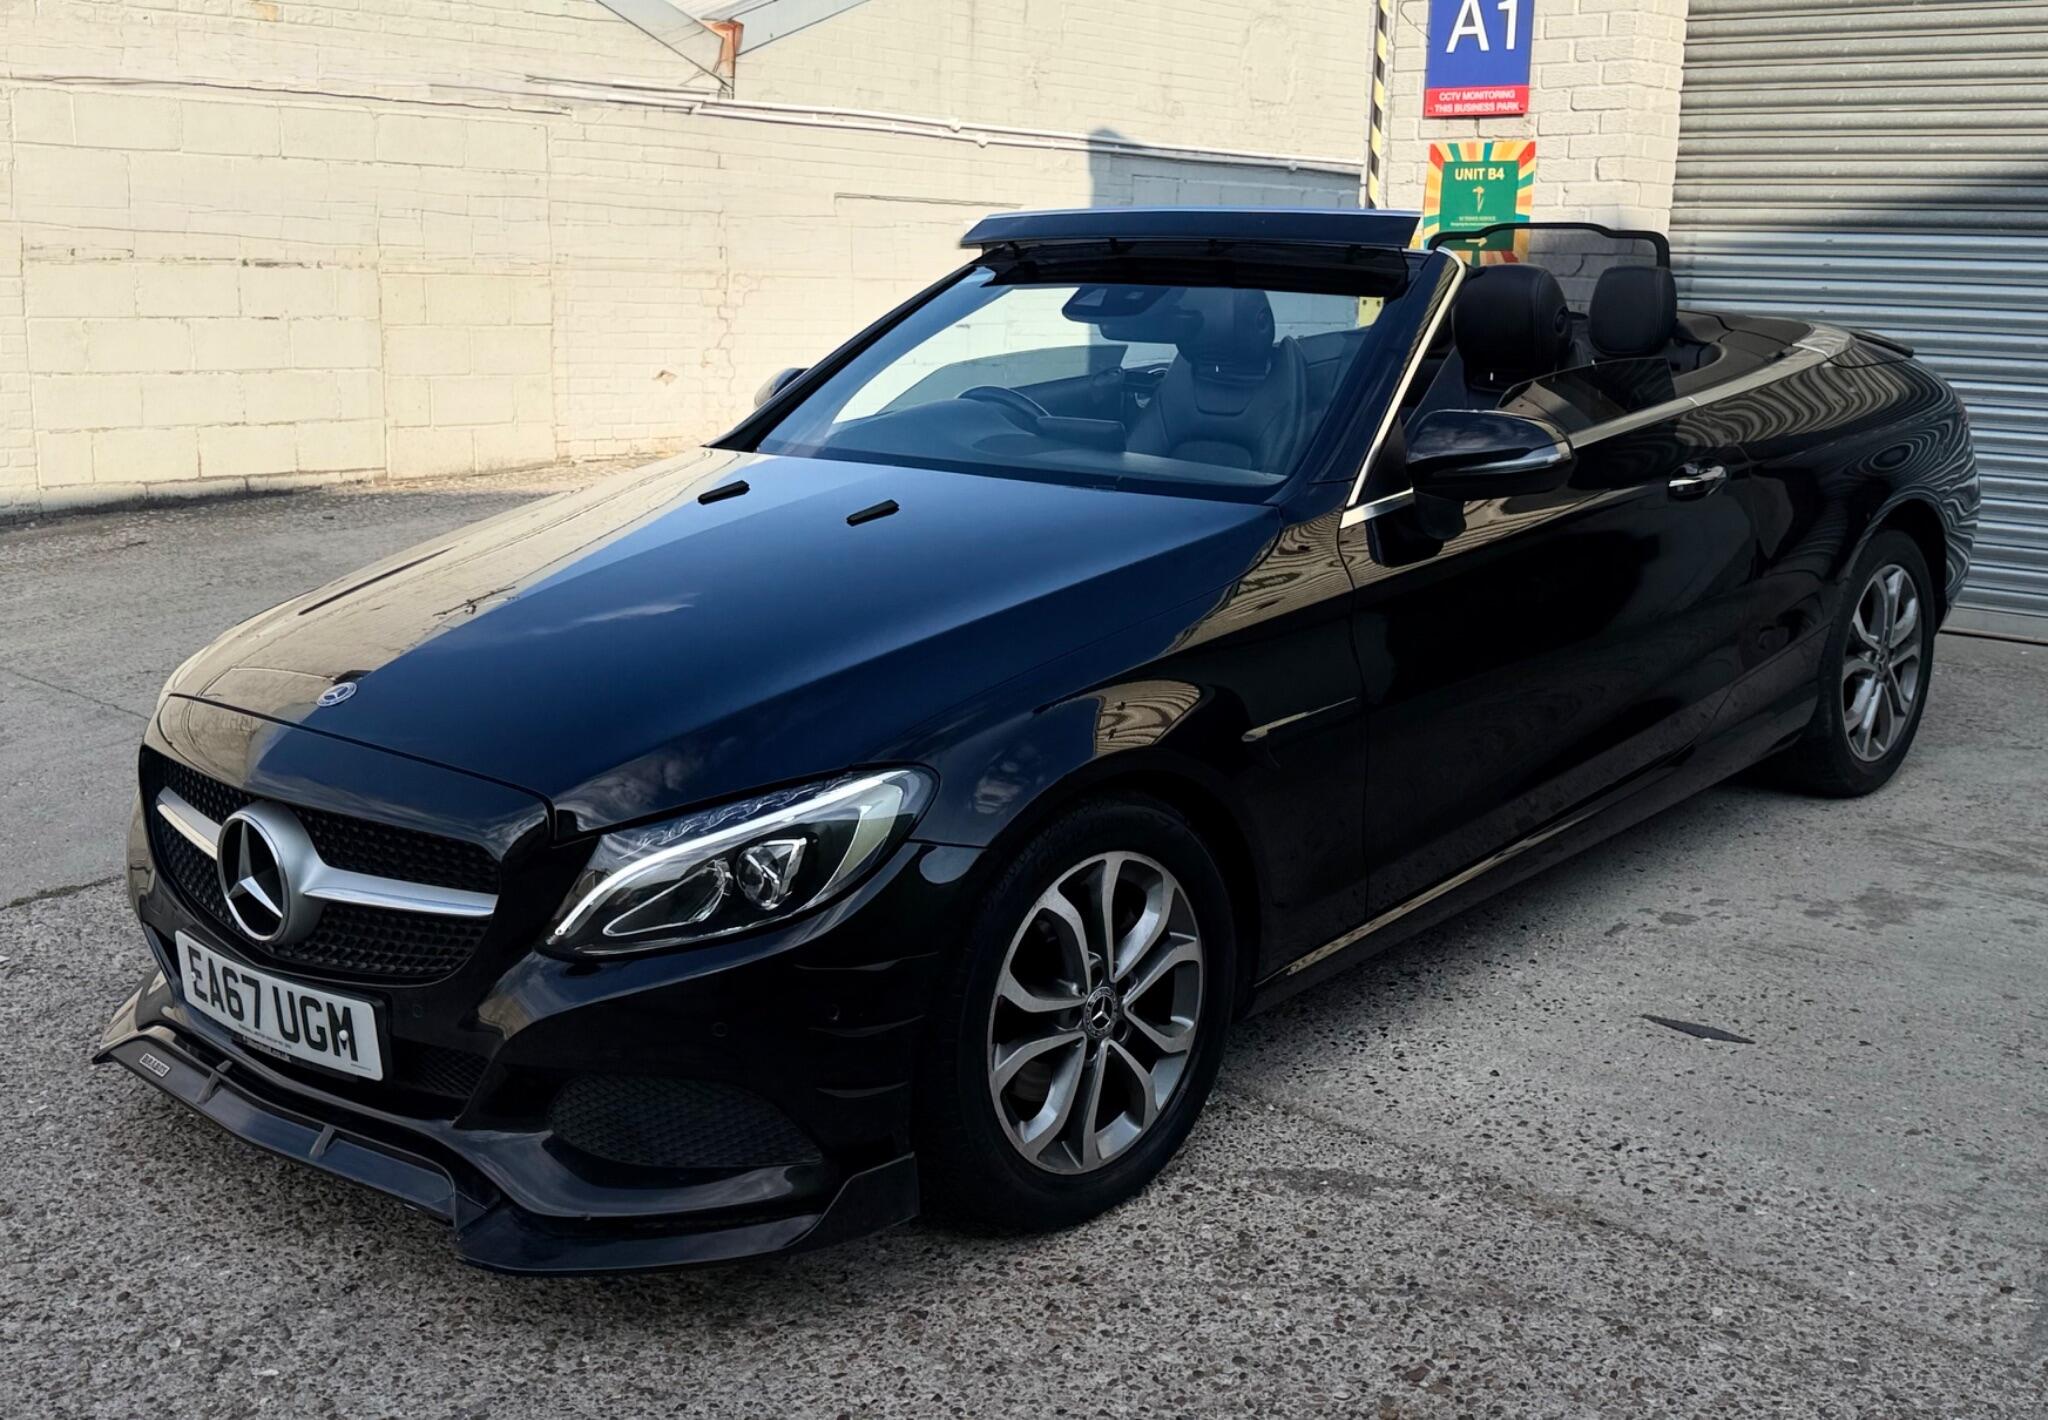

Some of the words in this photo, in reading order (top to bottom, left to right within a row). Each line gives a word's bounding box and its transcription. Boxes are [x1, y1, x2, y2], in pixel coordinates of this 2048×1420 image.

[1446, 0, 1518, 53] A1
[1439, 92, 1461, 100] CCTV
[1462, 90, 1515, 100] MONITORING
[1434, 103, 1453, 112] THIS
[1454, 102, 1495, 112] BUSINESS
[1496, 101, 1520, 111] PARK
[1455, 168, 1485, 181] UNIT
[1487, 167, 1505, 180] B4
[187, 945, 261, 1029] EA67
[271, 986, 359, 1062] UGM
